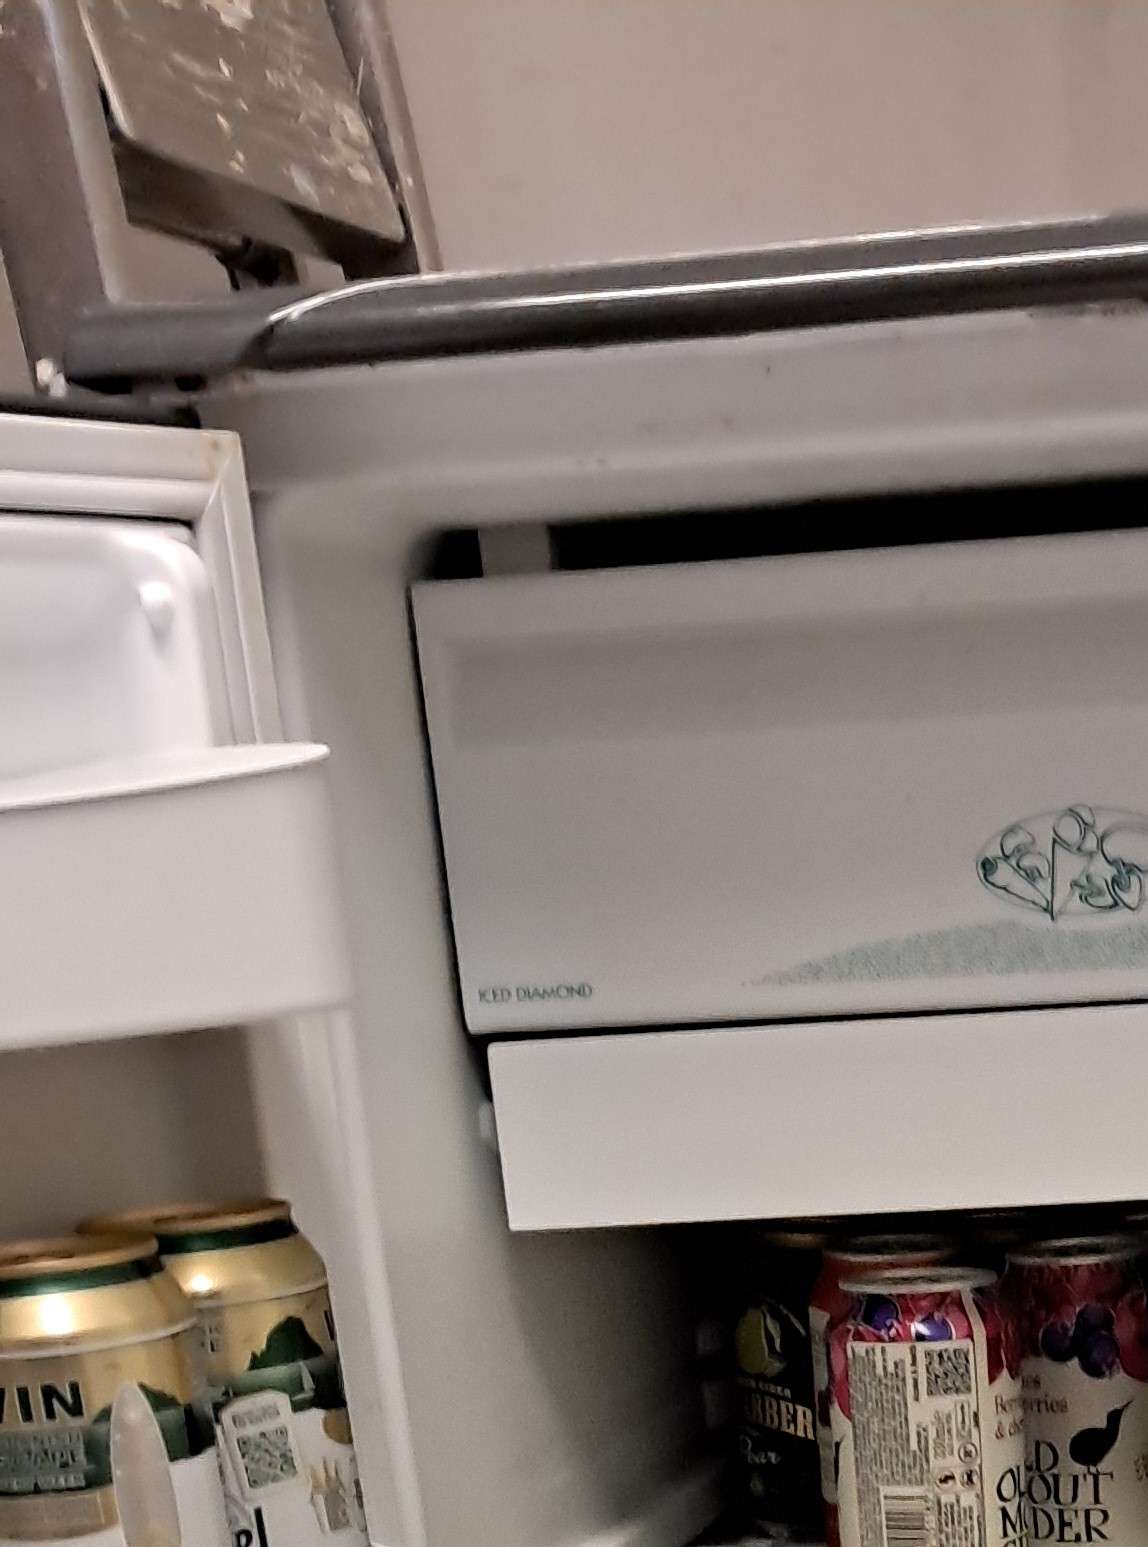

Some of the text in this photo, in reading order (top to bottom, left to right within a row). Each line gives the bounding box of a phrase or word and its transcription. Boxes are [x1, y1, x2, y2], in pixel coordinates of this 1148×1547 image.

[515, 983, 593, 1001] DIAMOND
[1028, 1465, 1114, 1505] OUT
[1032, 1506, 1109, 1543] DER
